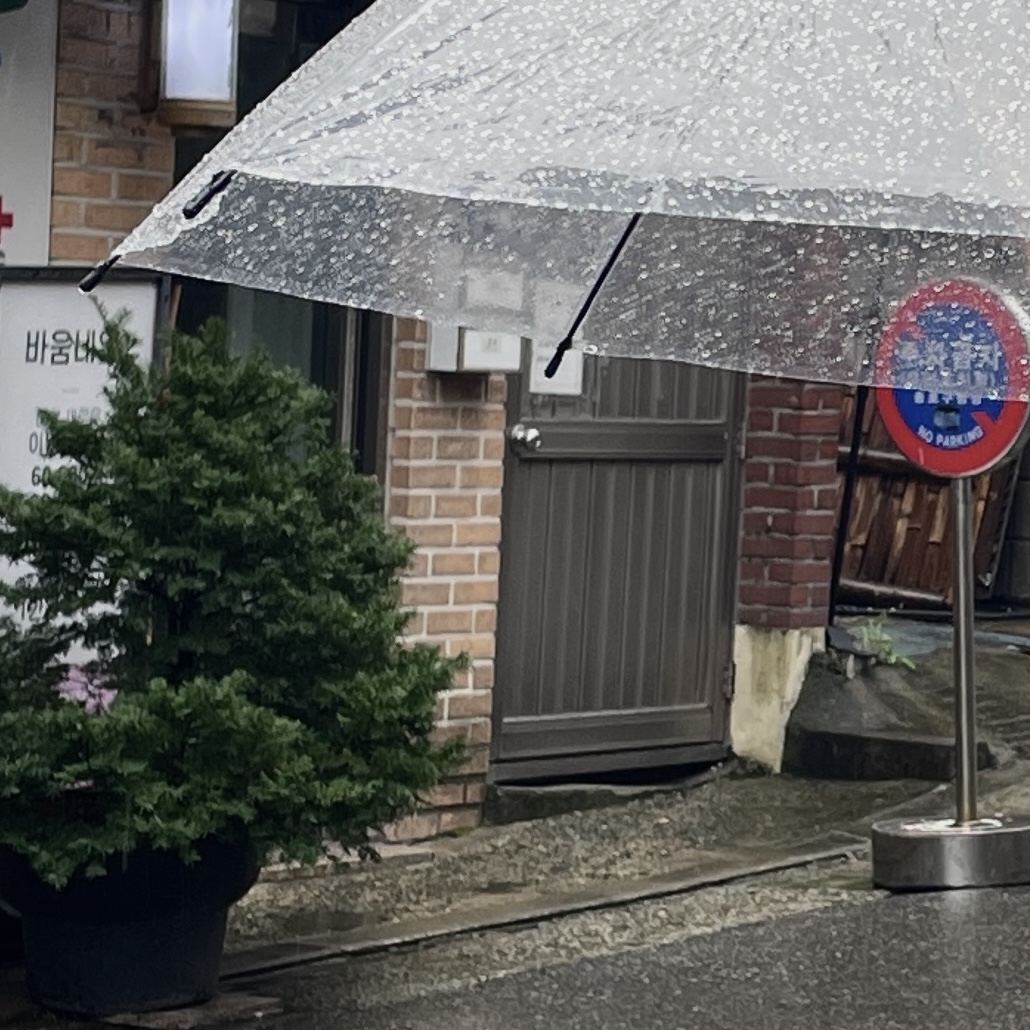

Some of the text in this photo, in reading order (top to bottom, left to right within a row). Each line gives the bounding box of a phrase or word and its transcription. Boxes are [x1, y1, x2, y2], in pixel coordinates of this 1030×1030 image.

[25, 328, 115, 365] 바움네
[918, 425, 984, 448] NO PARKING
